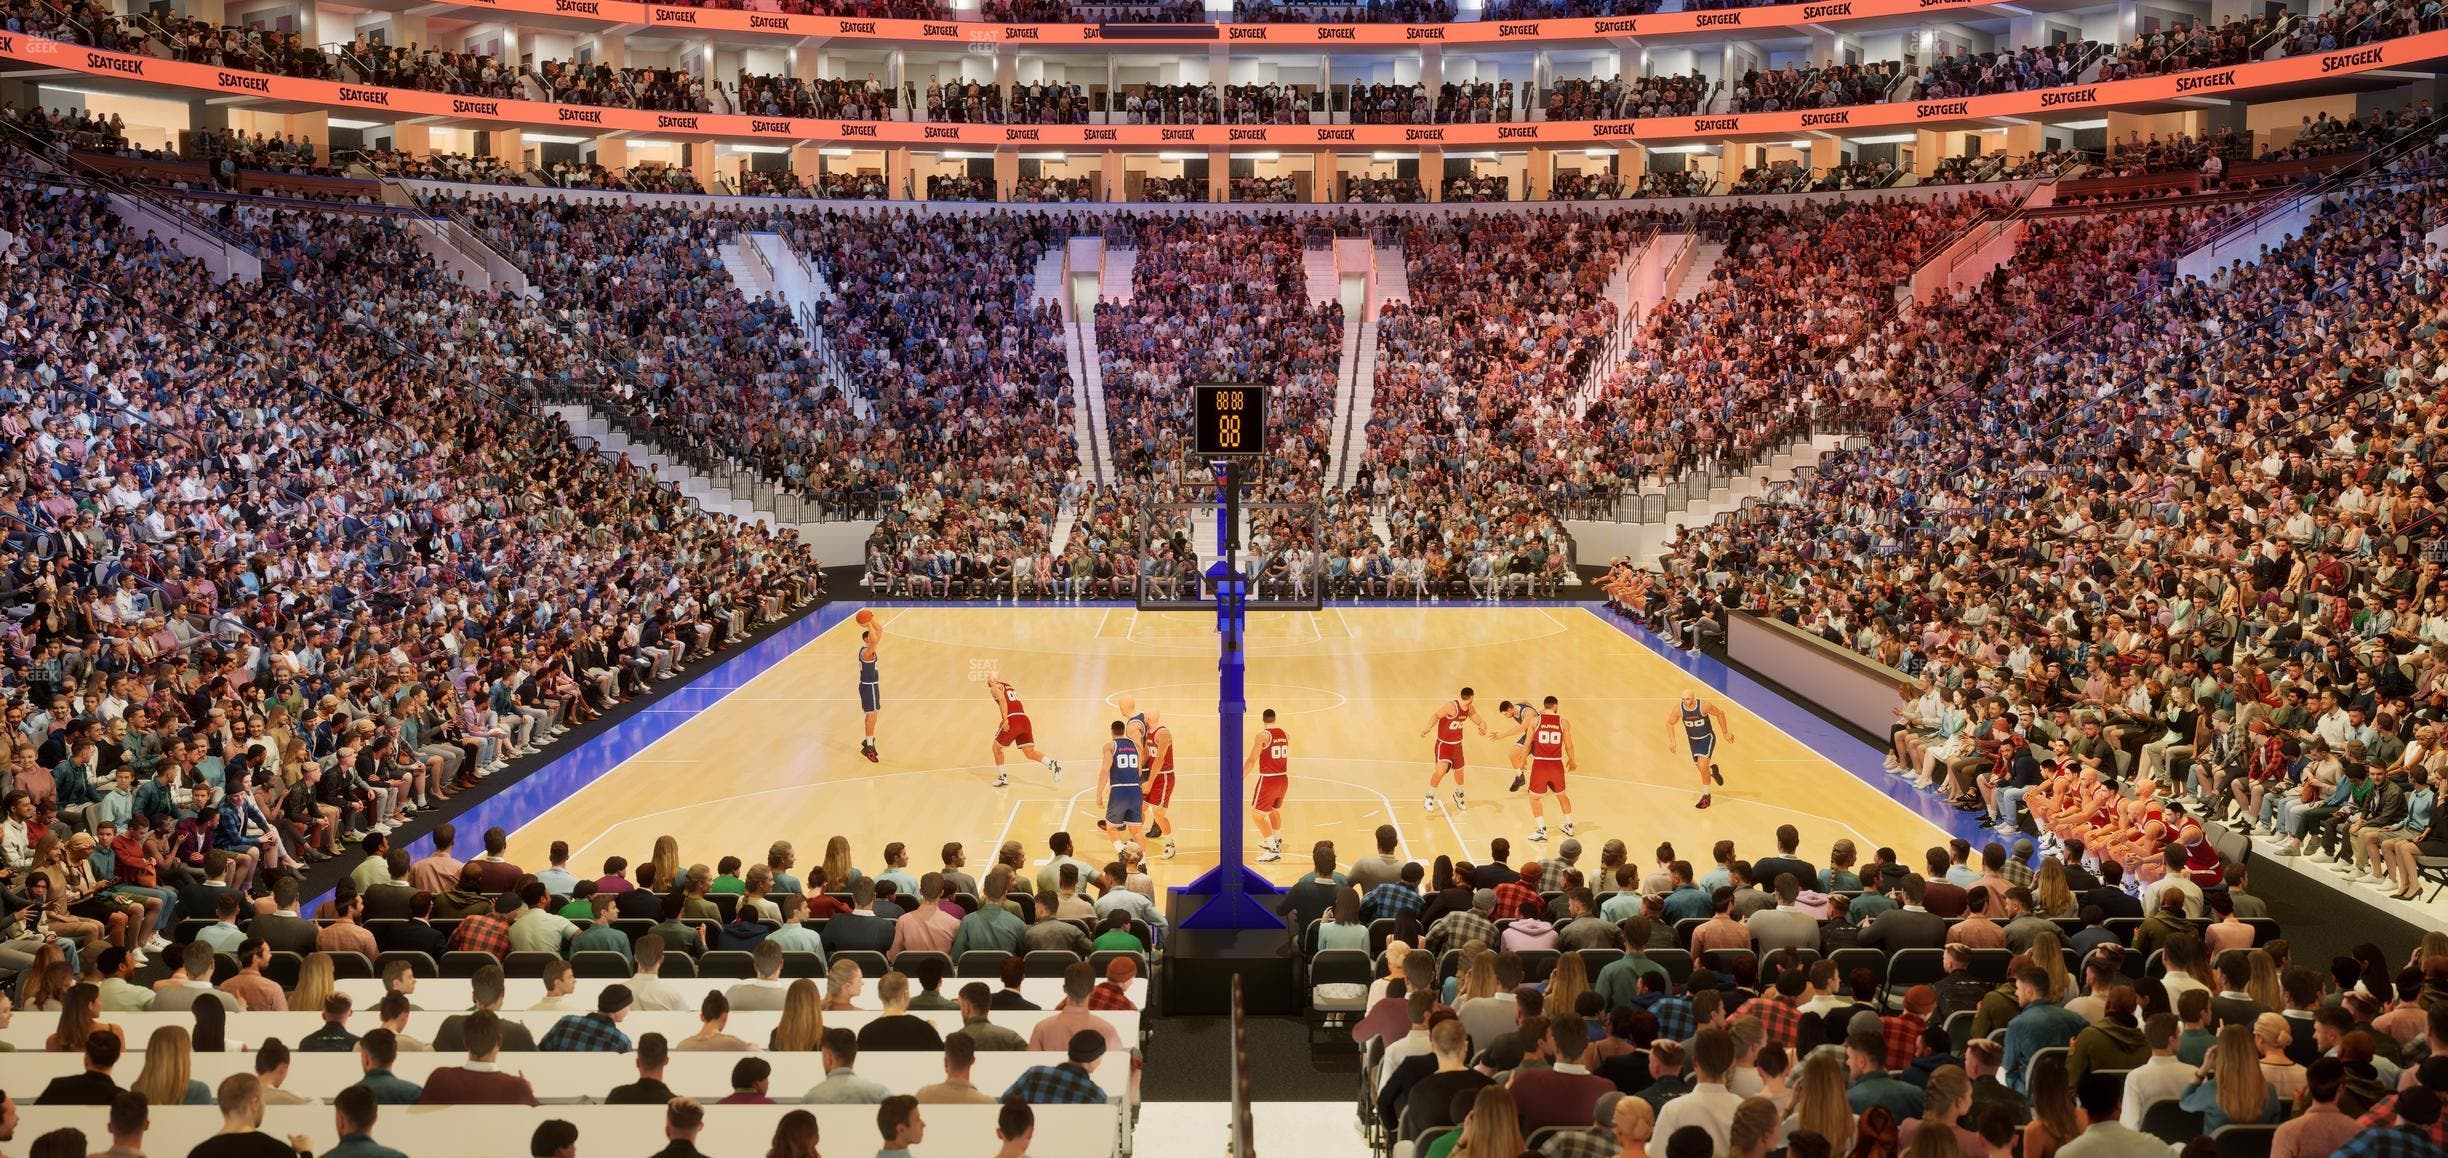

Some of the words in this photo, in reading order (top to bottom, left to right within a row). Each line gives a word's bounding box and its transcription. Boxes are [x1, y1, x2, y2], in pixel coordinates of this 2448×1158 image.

[556, 0, 599, 16] SEATGEEK
[1803, 2, 1852, 20] SEATGEEK
[655, 8, 697, 24] SEATGEEK
[750, 15, 789, 30] SEATGEEK
[1696, 12, 1741, 28] SEATGEEK
[840, 21, 876, 34] SEATGEEK
[923, 24, 959, 38] SEATGEEK
[1005, 27, 1039, 40] SEATGEEK
[1083, 27, 1102, 40] SEAT
[1229, 27, 1267, 40] SEATGEEK
[1317, 27, 1356, 40] SEATGEEK
[1406, 27, 1445, 40] SEATGEEK
[1499, 23, 1540, 37] SEATGEEK
[1594, 19, 1637, 34] SEATGEEK
[87, 52, 144, 76] SEATGEEK
[2321, 46, 2384, 73] SEATGEEK
[218, 71, 270, 93] SEATGEEK
[2176, 70, 2235, 93] SEATGEEK
[339, 87, 389, 106] SEATGEEK
[2040, 87, 2097, 107] SEATGEEK
[453, 99, 499, 116] SEATGEEK
[1916, 101, 1969, 118] SEATGEEK
[558, 108, 602, 124] SEATGEEK
[658, 115, 699, 130] SEATGEEK
[1801, 110, 1849, 127] SEATGEEK
[751, 120, 791, 134] SEATGEEK
[841, 124, 877, 137] SEATGEEK
[1498, 125, 1538, 139] SEATGEEK
[1593, 122, 1635, 137] SEATGEEK
[1694, 117, 1739, 132] SEATGEEK
[924, 126, 960, 139] SEATGEEK
[1006, 128, 1040, 141] SEATGEEK
[1084, 128, 1117, 141] SEATGEEK
[1161, 128, 1195, 141] SEATGEEK
[1229, 128, 1267, 141] SEATGEEK
[1317, 128, 1355, 141] SEATGEEK
[1405, 128, 1444, 141] SEATGEEK
[1216, 391, 1229, 411] 88
[1231, 391, 1244, 411] 88
[1219, 415, 1241, 448] 88
[1683, 719, 1705, 728] 00
[1538, 730, 1561, 744] 00
[1116, 753, 1139, 769] 00
